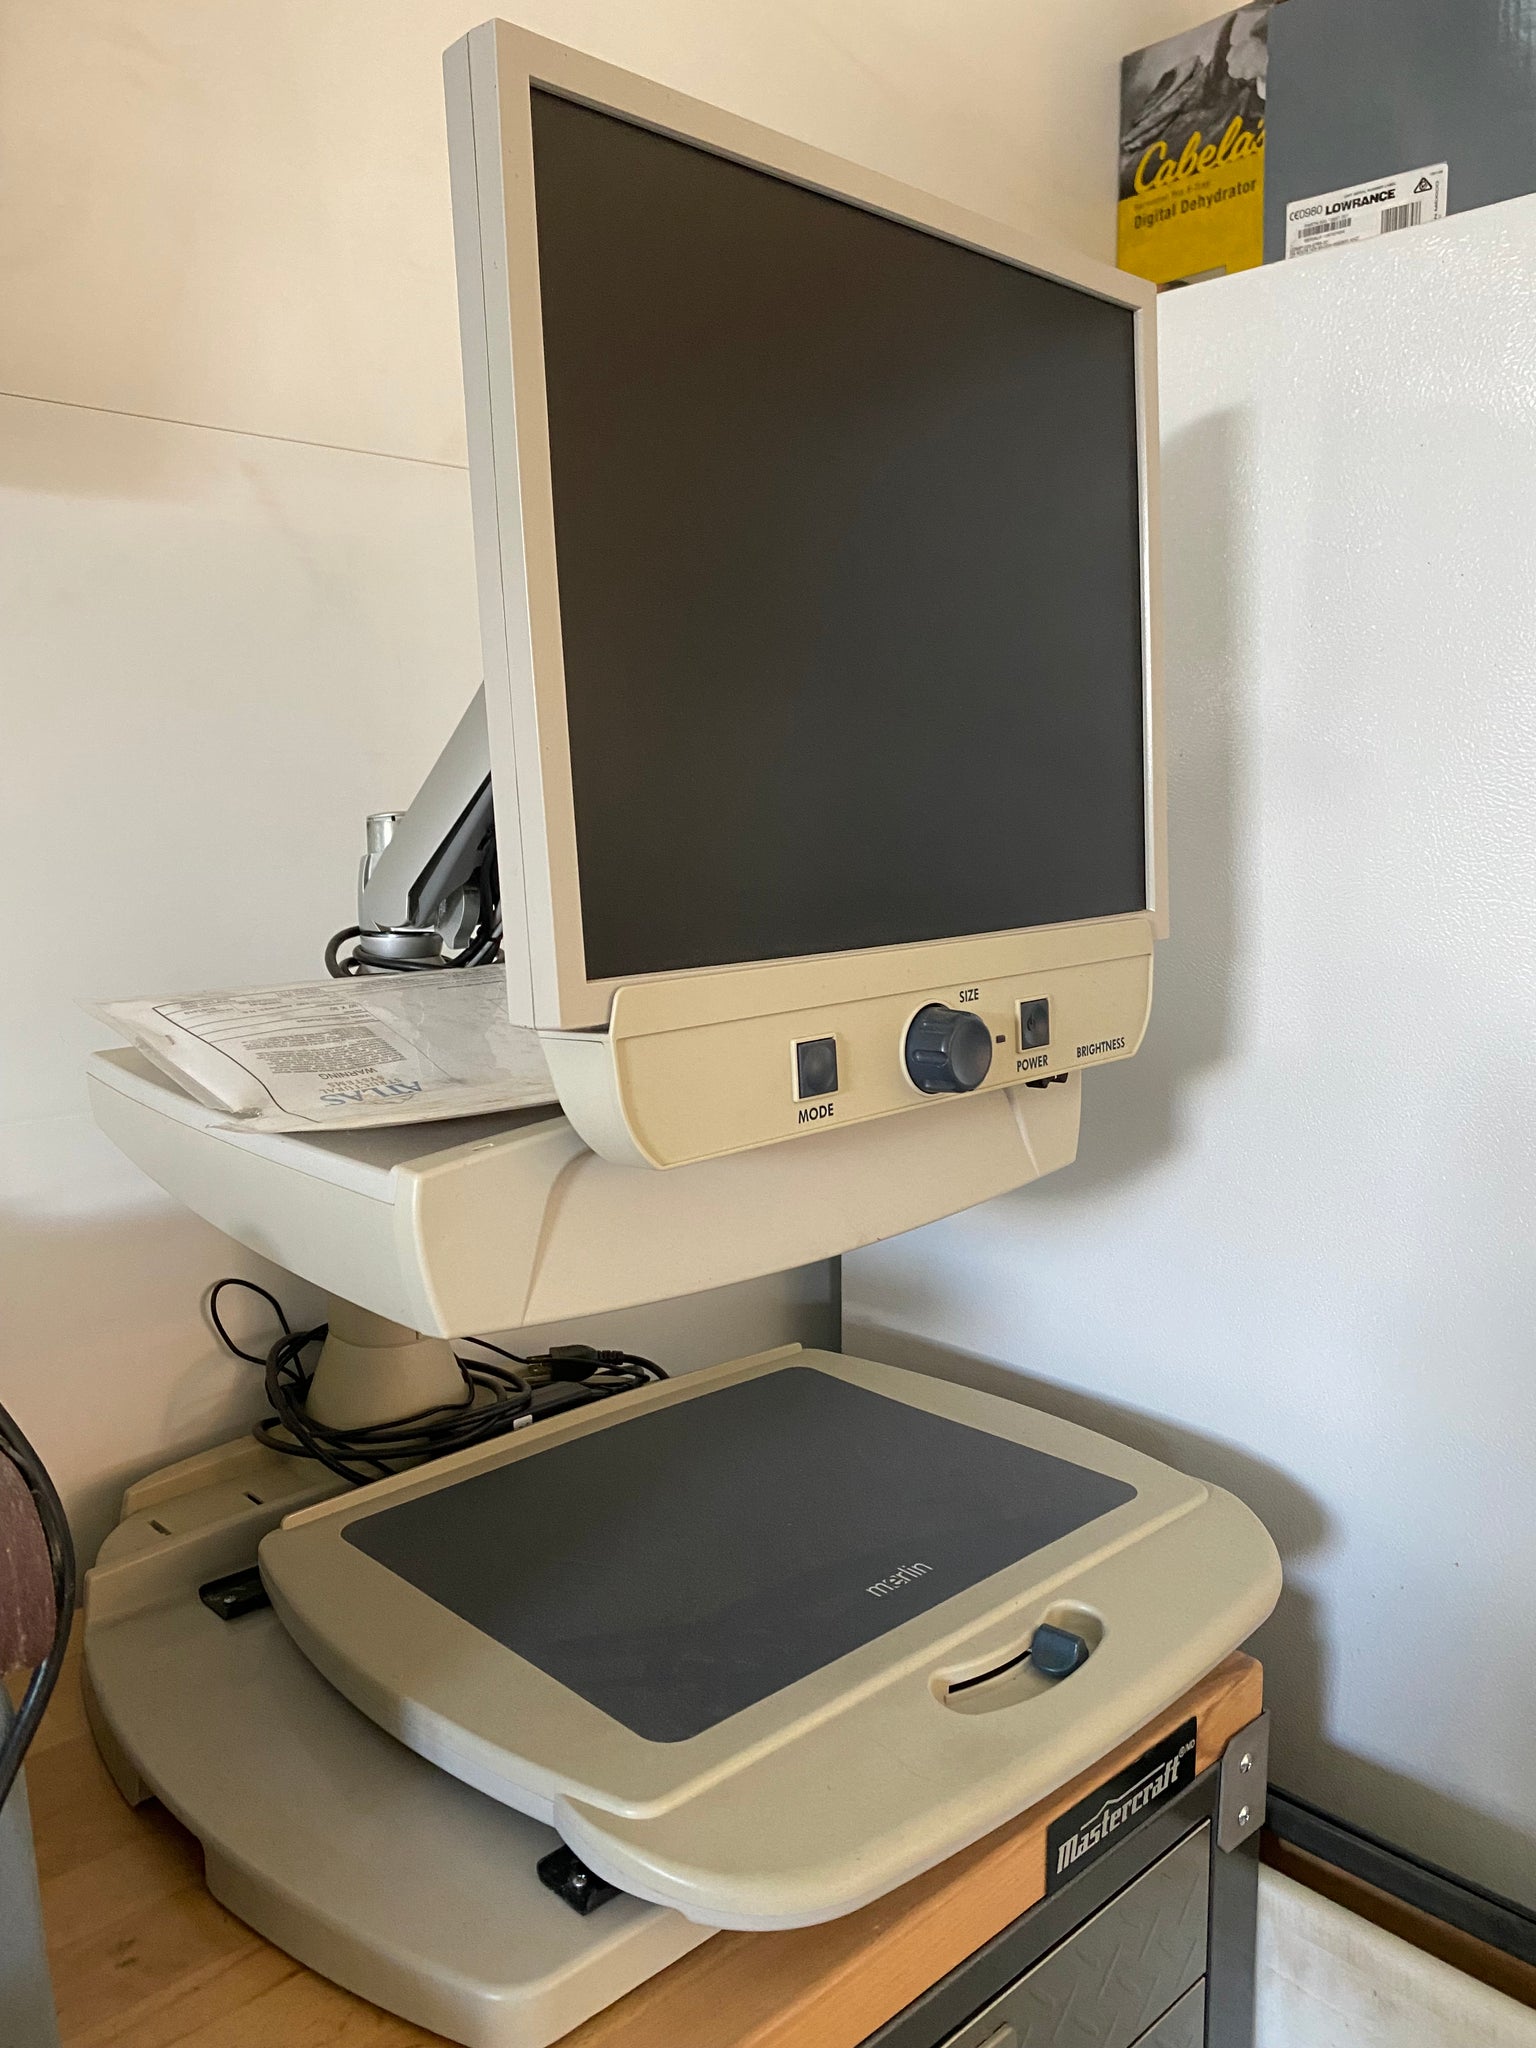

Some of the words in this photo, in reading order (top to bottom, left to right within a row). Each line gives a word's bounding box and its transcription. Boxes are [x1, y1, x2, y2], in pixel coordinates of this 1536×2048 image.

[1134, 203, 1177, 230] Digital
[1181, 179, 1257, 214] Dehydrator
[1325, 188, 1396, 215] LOWRANCE
[959, 987, 980, 1003] SIZE
[1076, 1036, 1126, 1059] BRIGHTNESS
[318, 1067, 378, 1080] WARNING
[1016, 1054, 1049, 1073] POWER
[320, 1080, 422, 1106] ATLAS
[798, 1102, 834, 1124] MODE
[865, 1562, 934, 1597] merlin
[1056, 1755, 1181, 1875] Mastercraft
